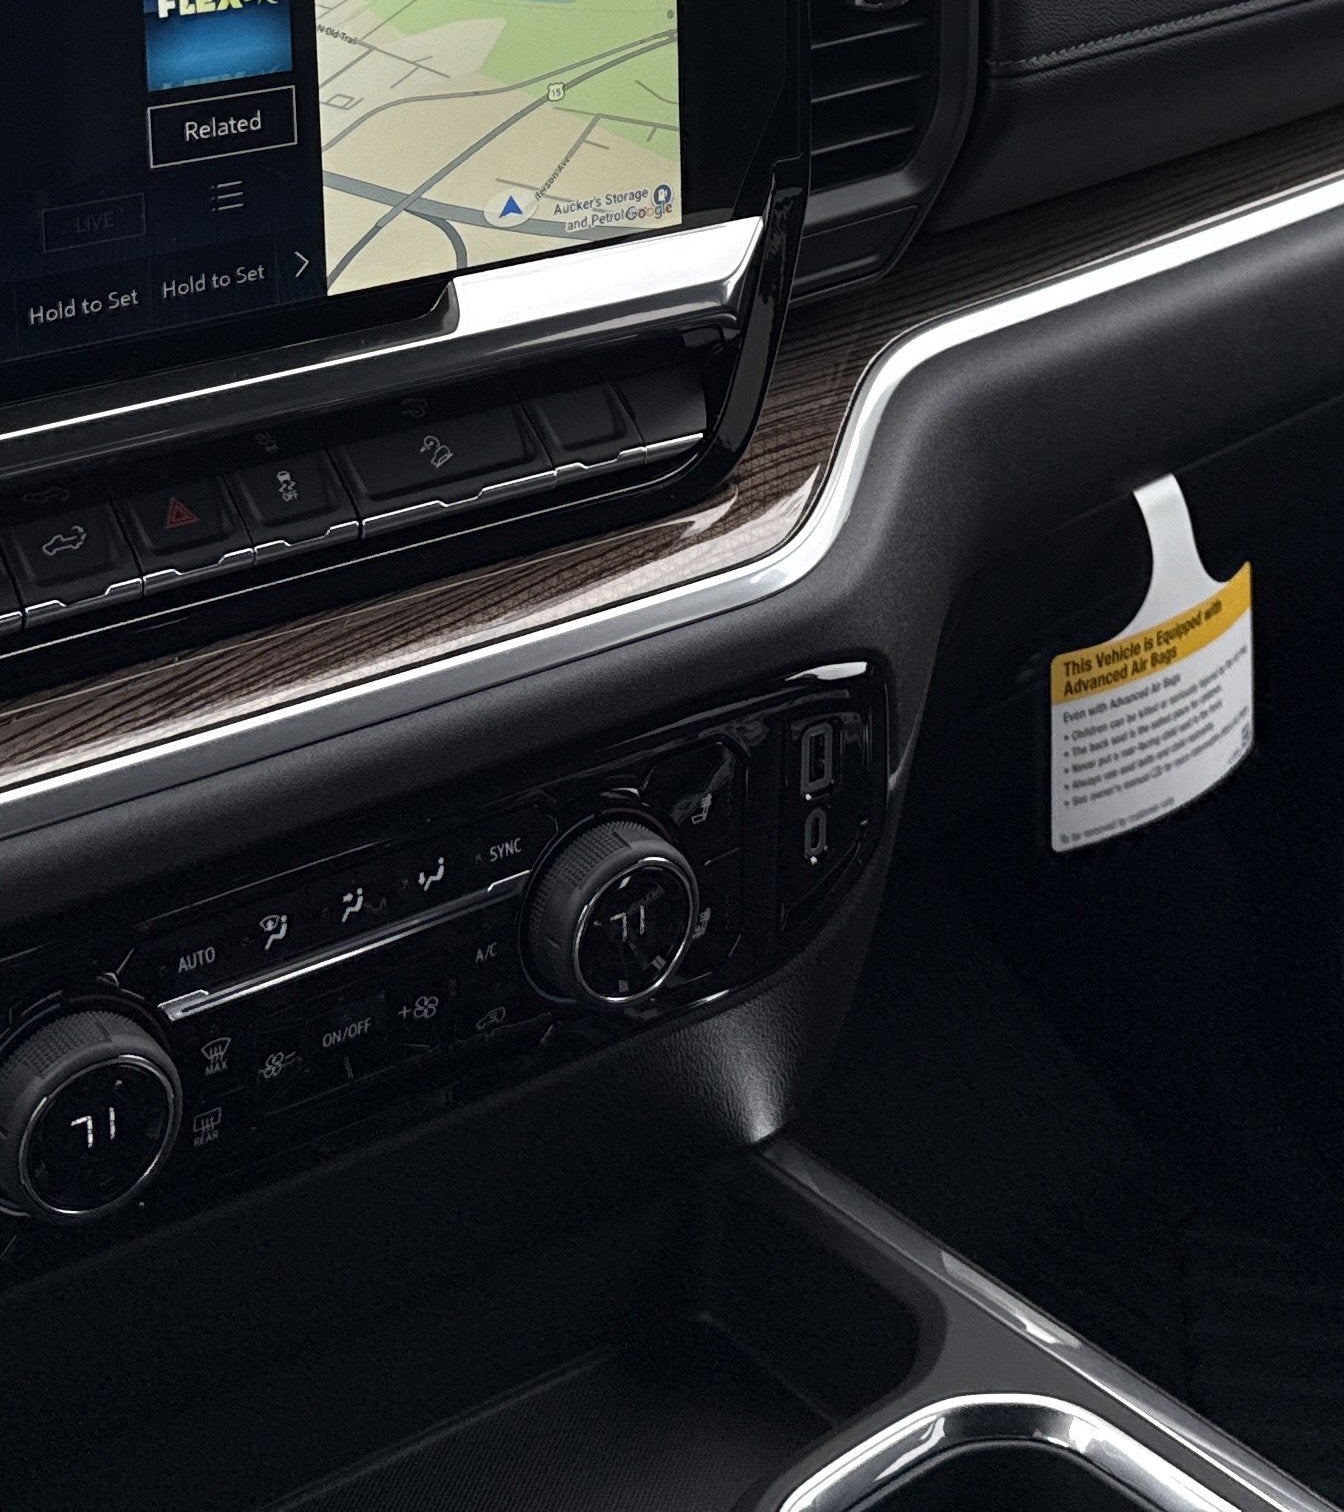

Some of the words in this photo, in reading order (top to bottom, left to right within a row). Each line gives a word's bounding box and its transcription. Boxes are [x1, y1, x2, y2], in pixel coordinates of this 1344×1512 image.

[184, 110, 262, 143] Related
[554, 196, 602, 216] Aucker's
[605, 188, 649, 207] Storage
[76, 211, 115, 234] LIVE
[567, 215, 588, 231] and
[162, 273, 206, 299] Hold
[211, 272, 231, 289] to
[235, 264, 265, 284] Set
[29, 298, 76, 326] Hold
[81, 297, 102, 316] to
[107, 289, 139, 310] Set
[1063, 657, 1092, 678] This
[1096, 641, 1141, 668] Vehicle
[1144, 636, 1154, 652] is
[1156, 609, 1202, 646] Equipped
[1064, 663, 1128, 697] Advanced
[1131, 657, 1148, 676] Air
[1151, 645, 1178, 668] Bags
[489, 837, 522, 863] SYNC
[178, 946, 216, 973] AUTO
[475, 942, 498, 964] A/C
[322, 1017, 372, 1048] ON/OFF
[205, 1058, 228, 1076] MAX
